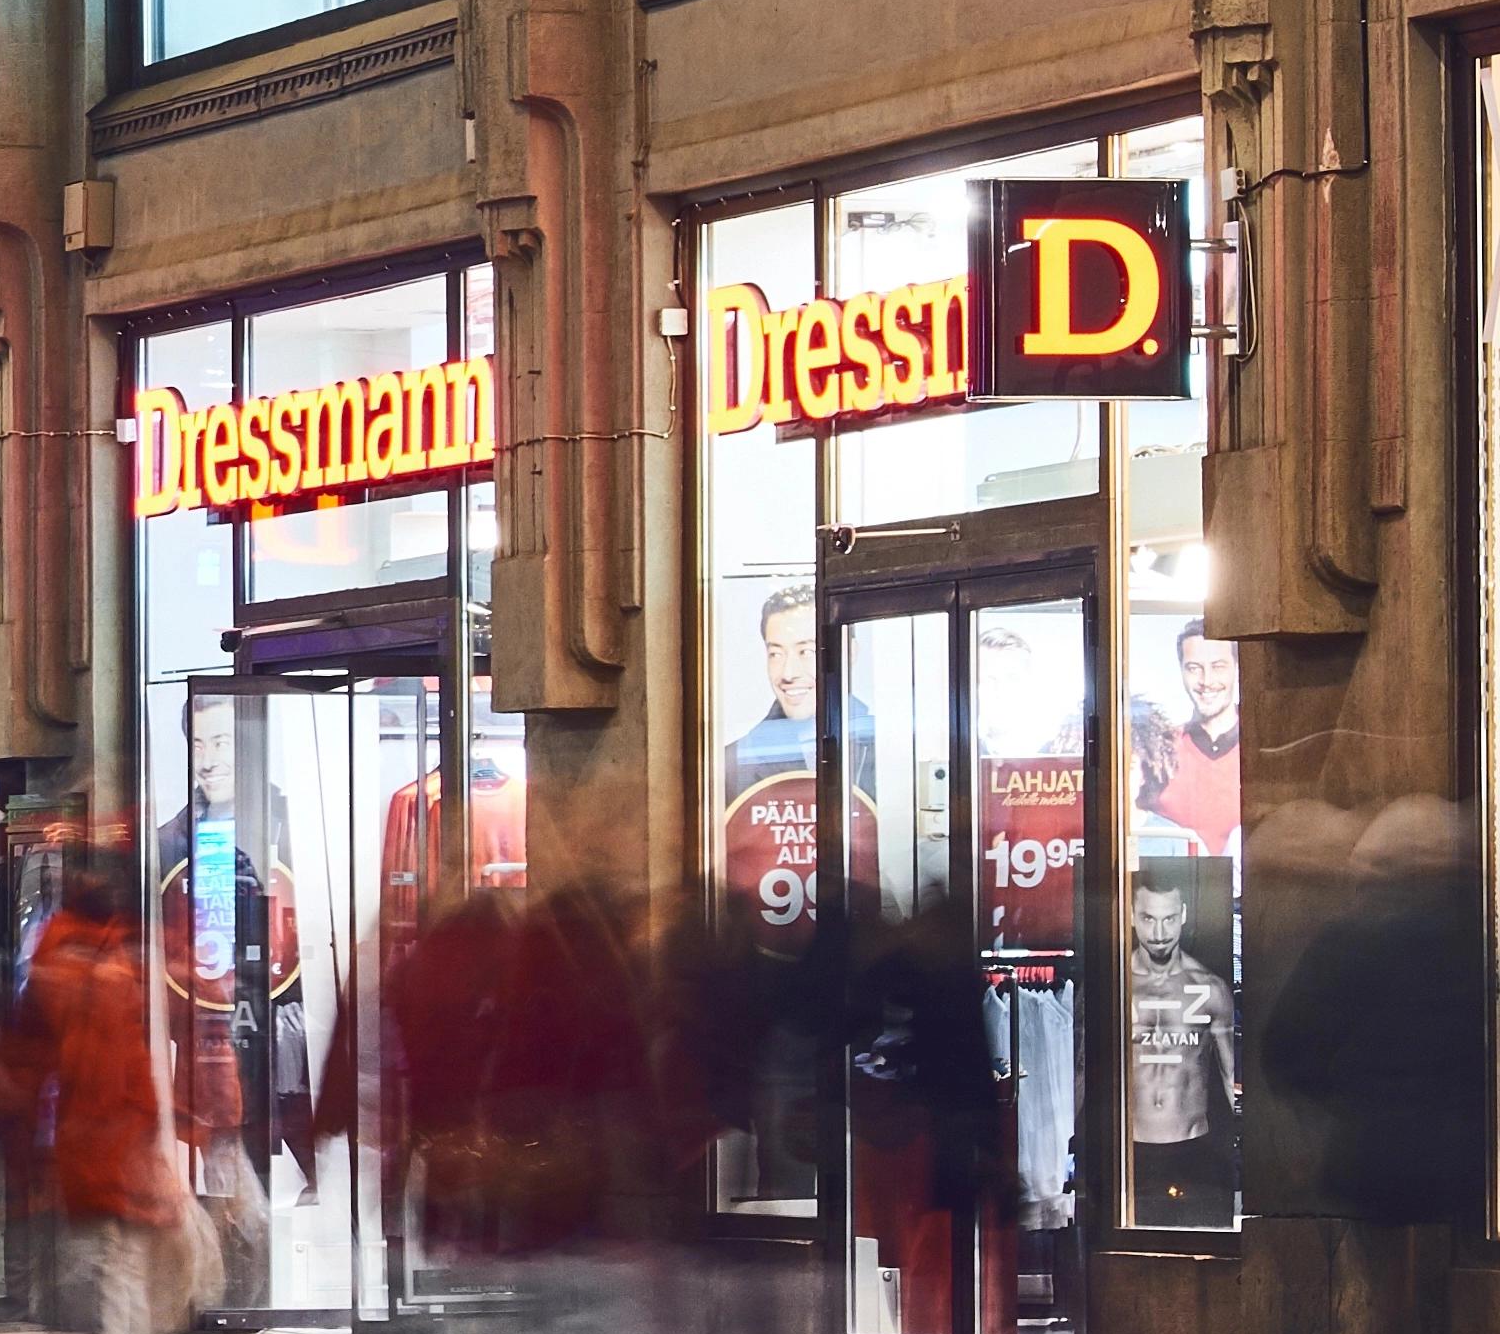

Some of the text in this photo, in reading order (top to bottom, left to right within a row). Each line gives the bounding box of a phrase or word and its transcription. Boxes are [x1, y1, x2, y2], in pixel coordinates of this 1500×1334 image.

[134, 354, 496, 518] Dressmann
[990, 769, 1085, 794] LAHJAT
[1141, 1032, 1199, 1046] ZLATAN
